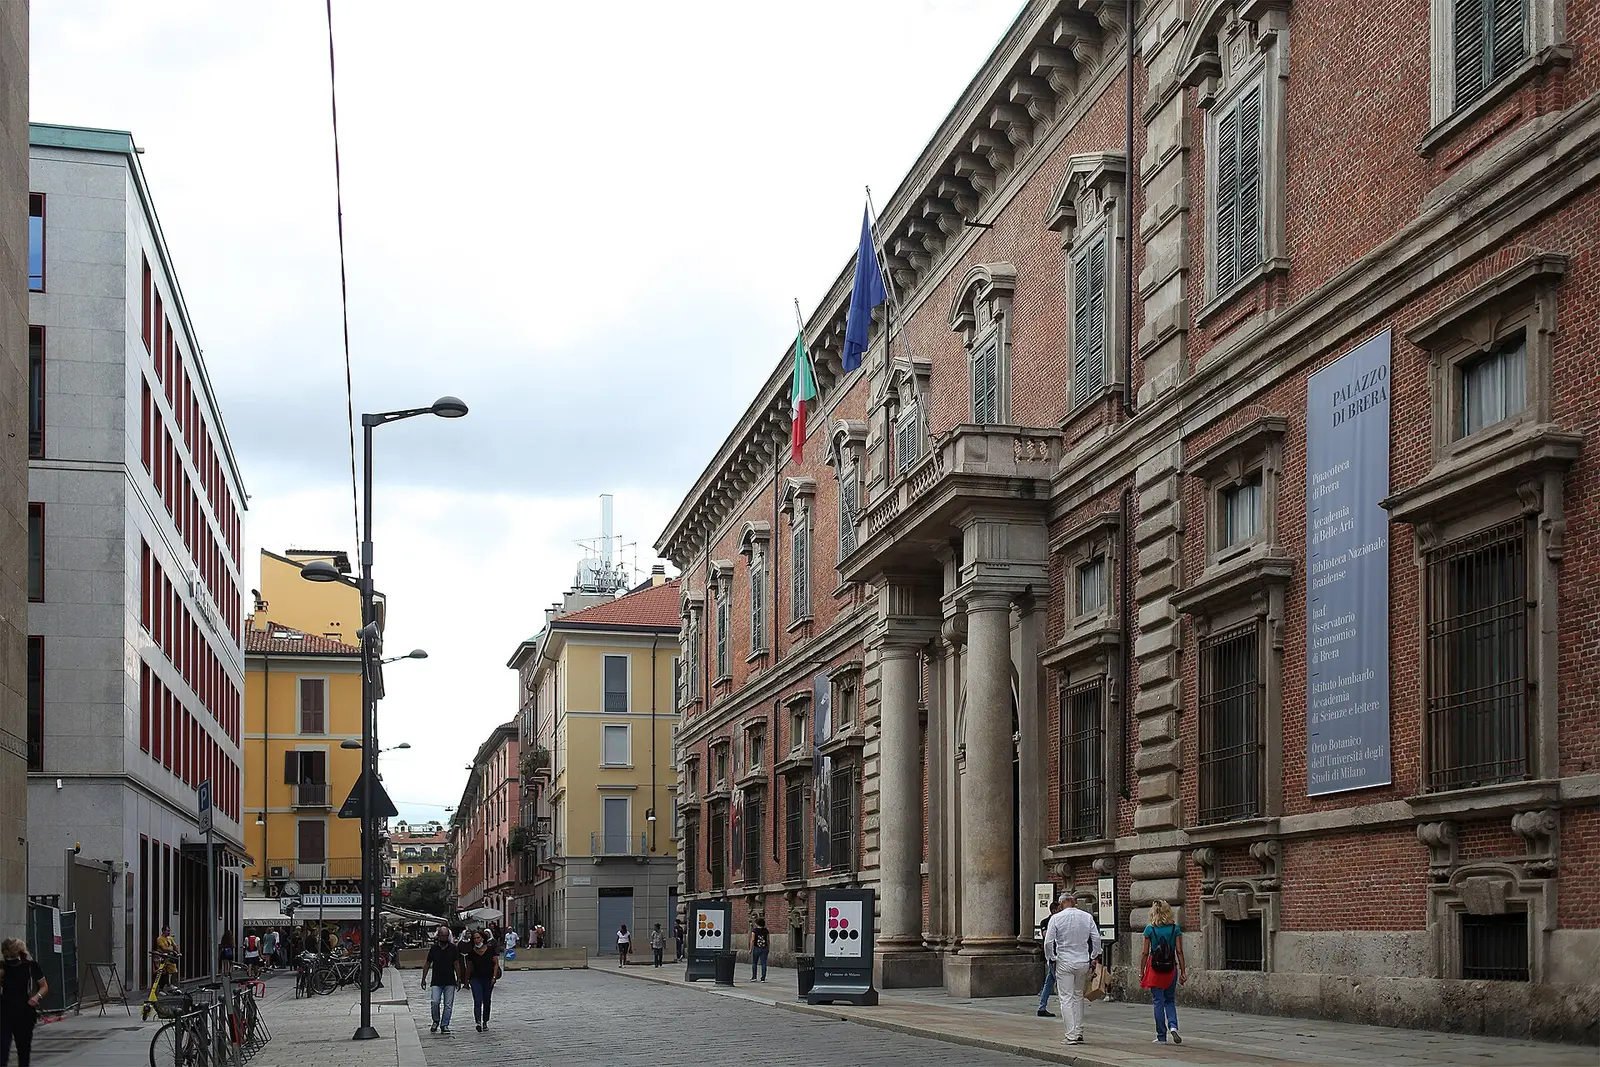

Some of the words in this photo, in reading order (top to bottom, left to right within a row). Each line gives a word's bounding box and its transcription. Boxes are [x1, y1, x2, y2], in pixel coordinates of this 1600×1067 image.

[1333, 364, 1387, 408] PALAZZO
[1332, 408, 1345, 428] DI
[1347, 386, 1388, 420] BRERA
[1312, 460, 1350, 485] Pinacoteca
[1312, 487, 1319, 500] di
[1320, 480, 1340, 497] Brera
[1312, 505, 1350, 530] Accademia
[1312, 531, 1319, 545] di
[1320, 525, 1338, 542] Belle
[1339, 517, 1354, 534] Arti
[1312, 554, 1347, 575] Biblioteca
[1348, 537, 1386, 560] Nazionale
[1312, 569, 1347, 590] Braidense
[1312, 604, 1326, 620] Inaf
[1312, 611, 1356, 634] Osservatorio
[1312, 628, 1356, 650] Astronomico
[1312, 652, 1319, 664] di
[1320, 649, 1340, 662] Brera
[1312, 680, 1337, 694] Istituto
[1338, 668, 1375, 688] lombardo
[1312, 690, 1350, 709] Accademia
[1312, 712, 1319, 724] di
[1320, 709, 1347, 722] Scienze
[1348, 707, 1354, 716] e
[1354, 700, 1380, 714] lettere
[1312, 742, 1328, 754] Orto
[1329, 735, 1362, 751] Botanico
[1312, 750, 1364, 769] dell'Università
[1364, 745, 1384, 761] degli
[1312, 770, 1330, 784] Studi
[1331, 769, 1339, 781] di
[1340, 766, 1366, 780] Milano
[201, 787, 208, 809] P
[309, 885, 361, 895] BRERA
[828, 929, 859, 944] 900
